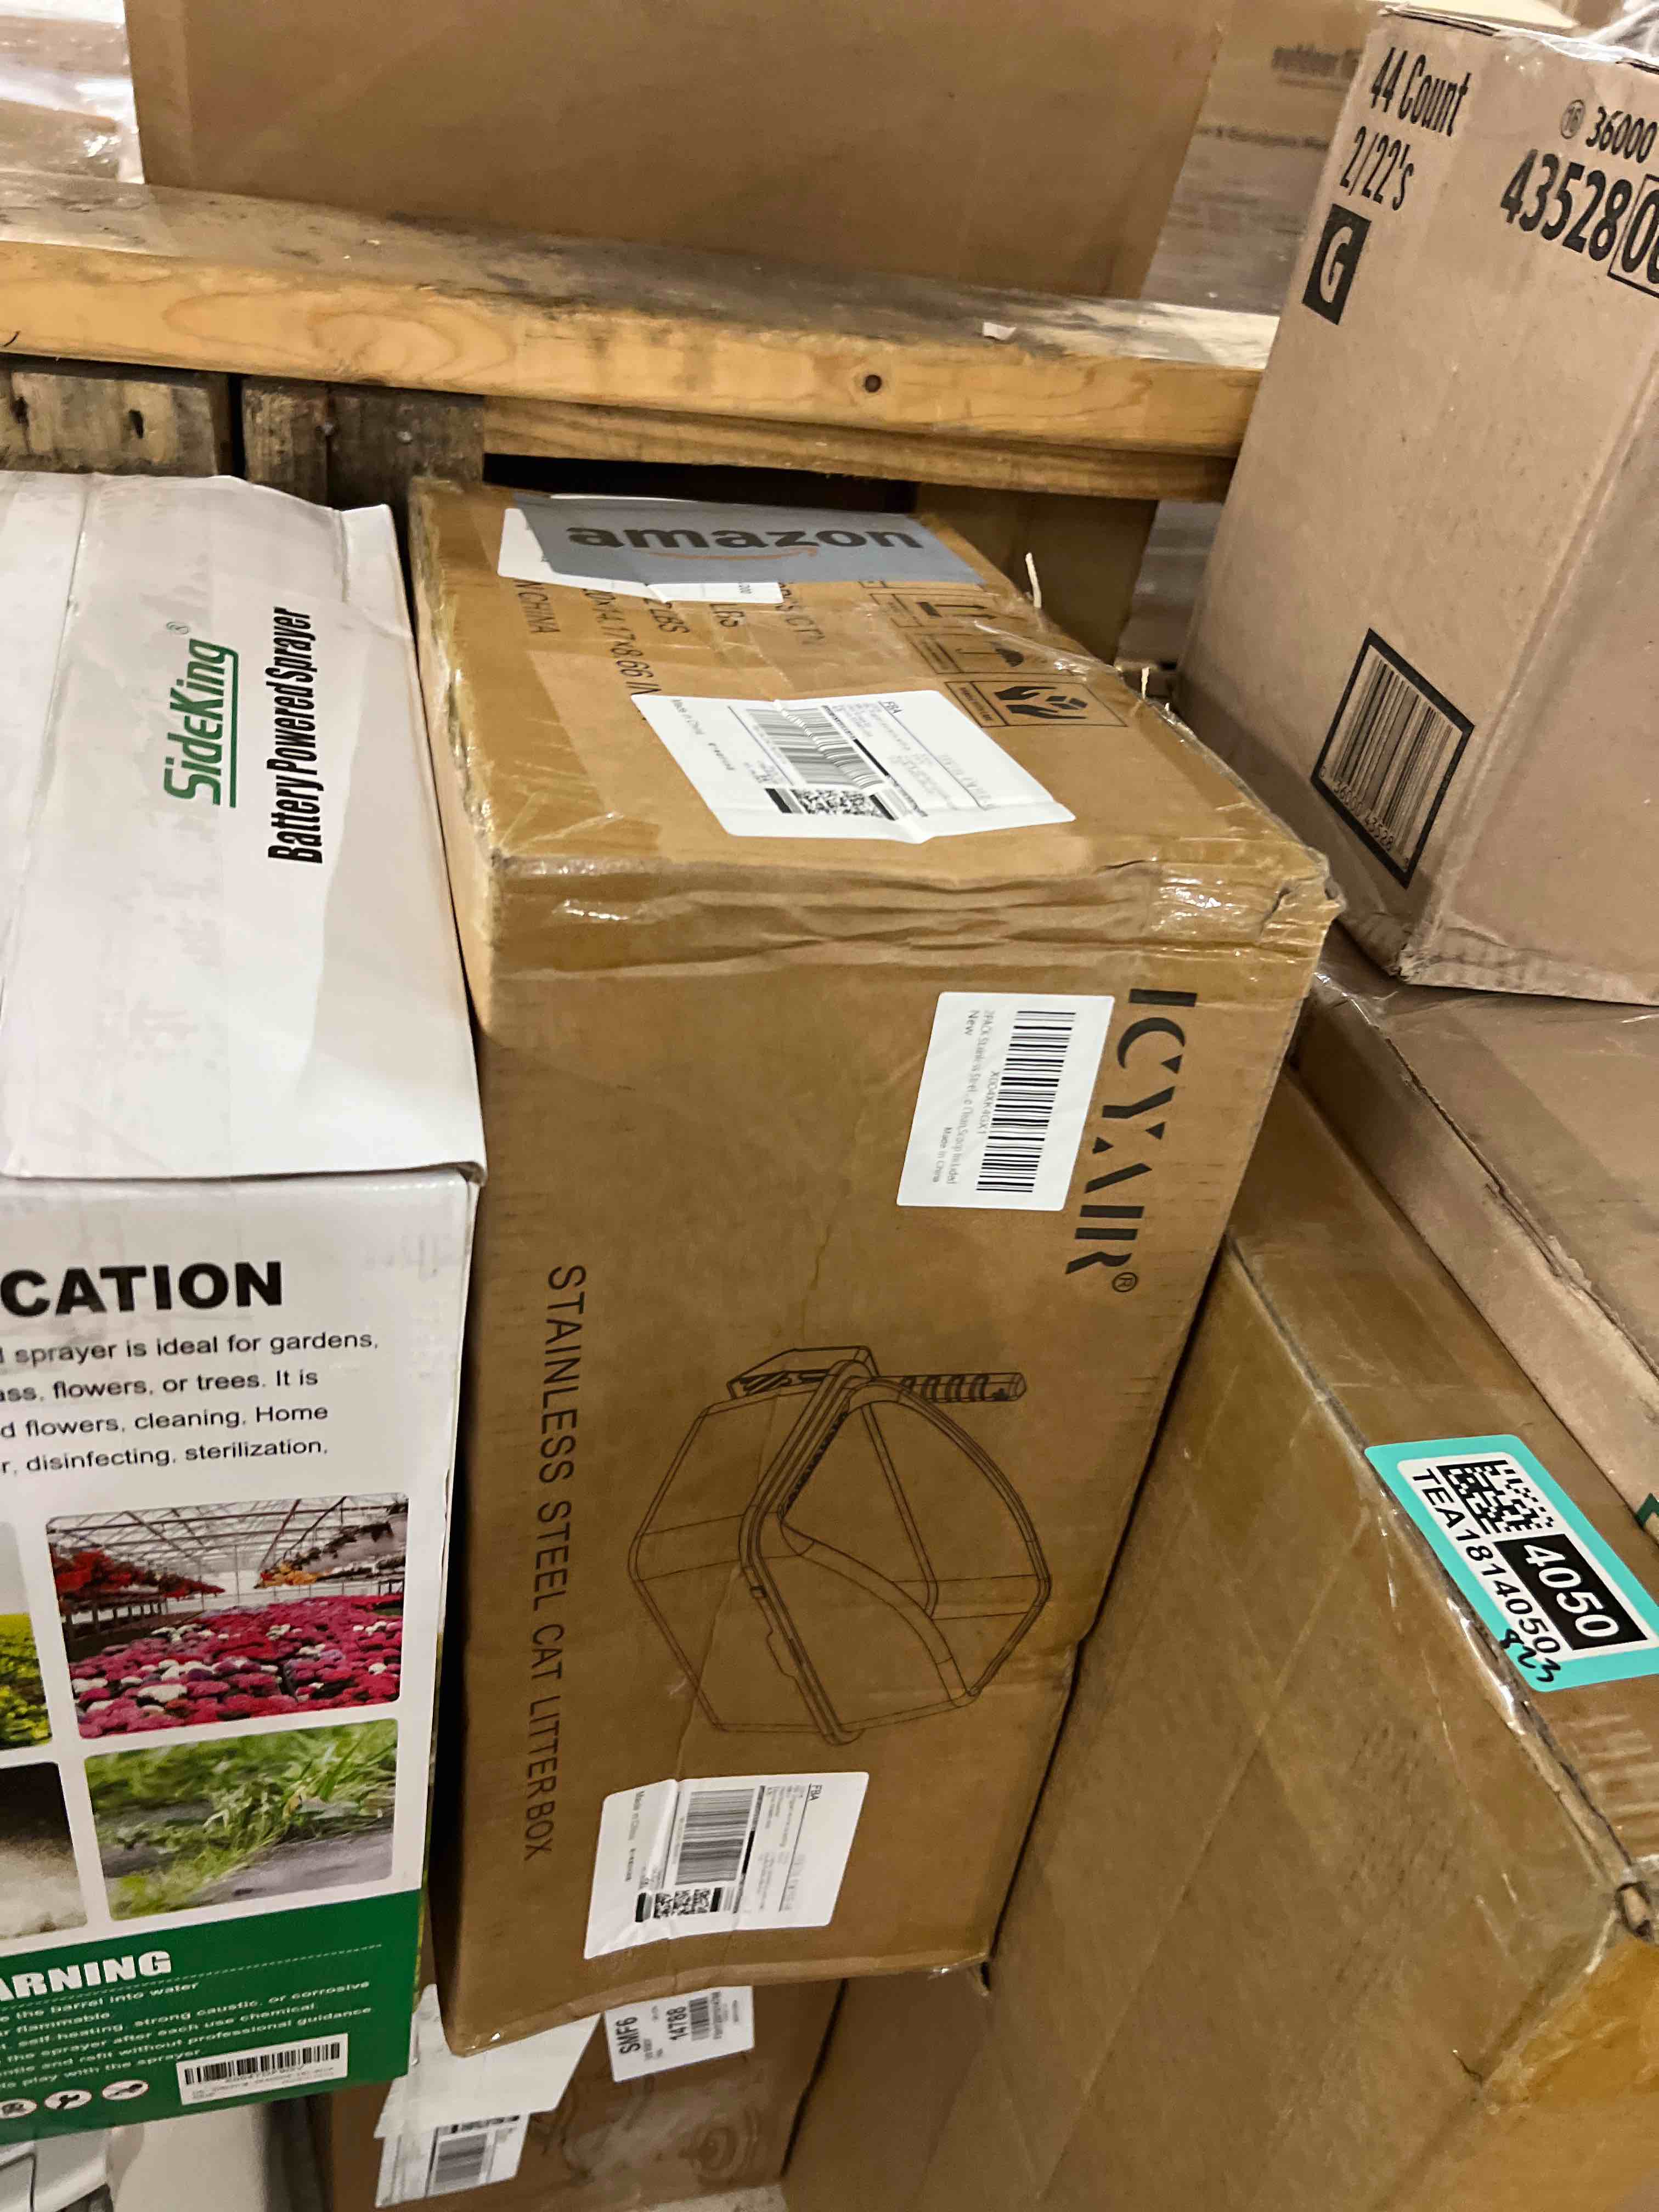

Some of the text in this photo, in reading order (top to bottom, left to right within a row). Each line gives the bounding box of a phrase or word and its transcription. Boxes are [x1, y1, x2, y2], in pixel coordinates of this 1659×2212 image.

[1370, 47, 1408, 112] 44
[1398, 54, 1472, 137] Count
[1586, 106, 1658, 163] 36000
[1340, 126, 1414, 211] 2/22's
[566, 527, 923, 549] amazon
[517, 592, 562, 634] CHINA
[163, 639, 239, 808] SideKing
[880, 701, 902, 714] FBA
[265, 606, 325, 864] Battery Powered Sprayer
[963, 1009, 980, 1036] New
[15, 1342, 117, 1368] sprayer
[126, 1340, 148, 1358] is
[156, 1335, 218, 1356] ideal
[227, 1333, 262, 1353] for
[270, 1332, 379, 1355] gardens,
[53, 1380, 154, 1400] flowers,
[162, 1375, 188, 1392] or
[276, 1370, 291, 1387] It
[299, 1369, 319, 1386] is
[26, 1416, 125, 1437] flowers,
[134, 1408, 246, 1430] cleaning,
[256, 1406, 329, 1424] Home
[26, 1447, 176, 1472] disinfecting,
[185, 1439, 328, 1462] sterilization,
[523, 1264, 586, 1861] STAINLESS STEEL CAT LITTER BOX
[1412, 1468, 1562, 1655] TEA1814050
[1524, 1544, 1620, 1639] 4050
[808, 1784, 823, 1802] FBA
[50, 1997, 103, 2013] barrel
[110, 1991, 144, 2003] into
[150, 1982, 199, 1996] water
[134, 2012, 191, 2027] strong
[291, 1980, 370, 2000] corrosive
[113, 2032, 153, 2045] after
[204, 2018, 234, 2029] use
[240, 2002, 315, 2022] chemical
[188, 2019, 292, 2045] professional
[297, 2007, 372, 2027] guidance
[616, 2016, 642, 2055] SMF6
[666, 2006, 689, 2041] 14788
